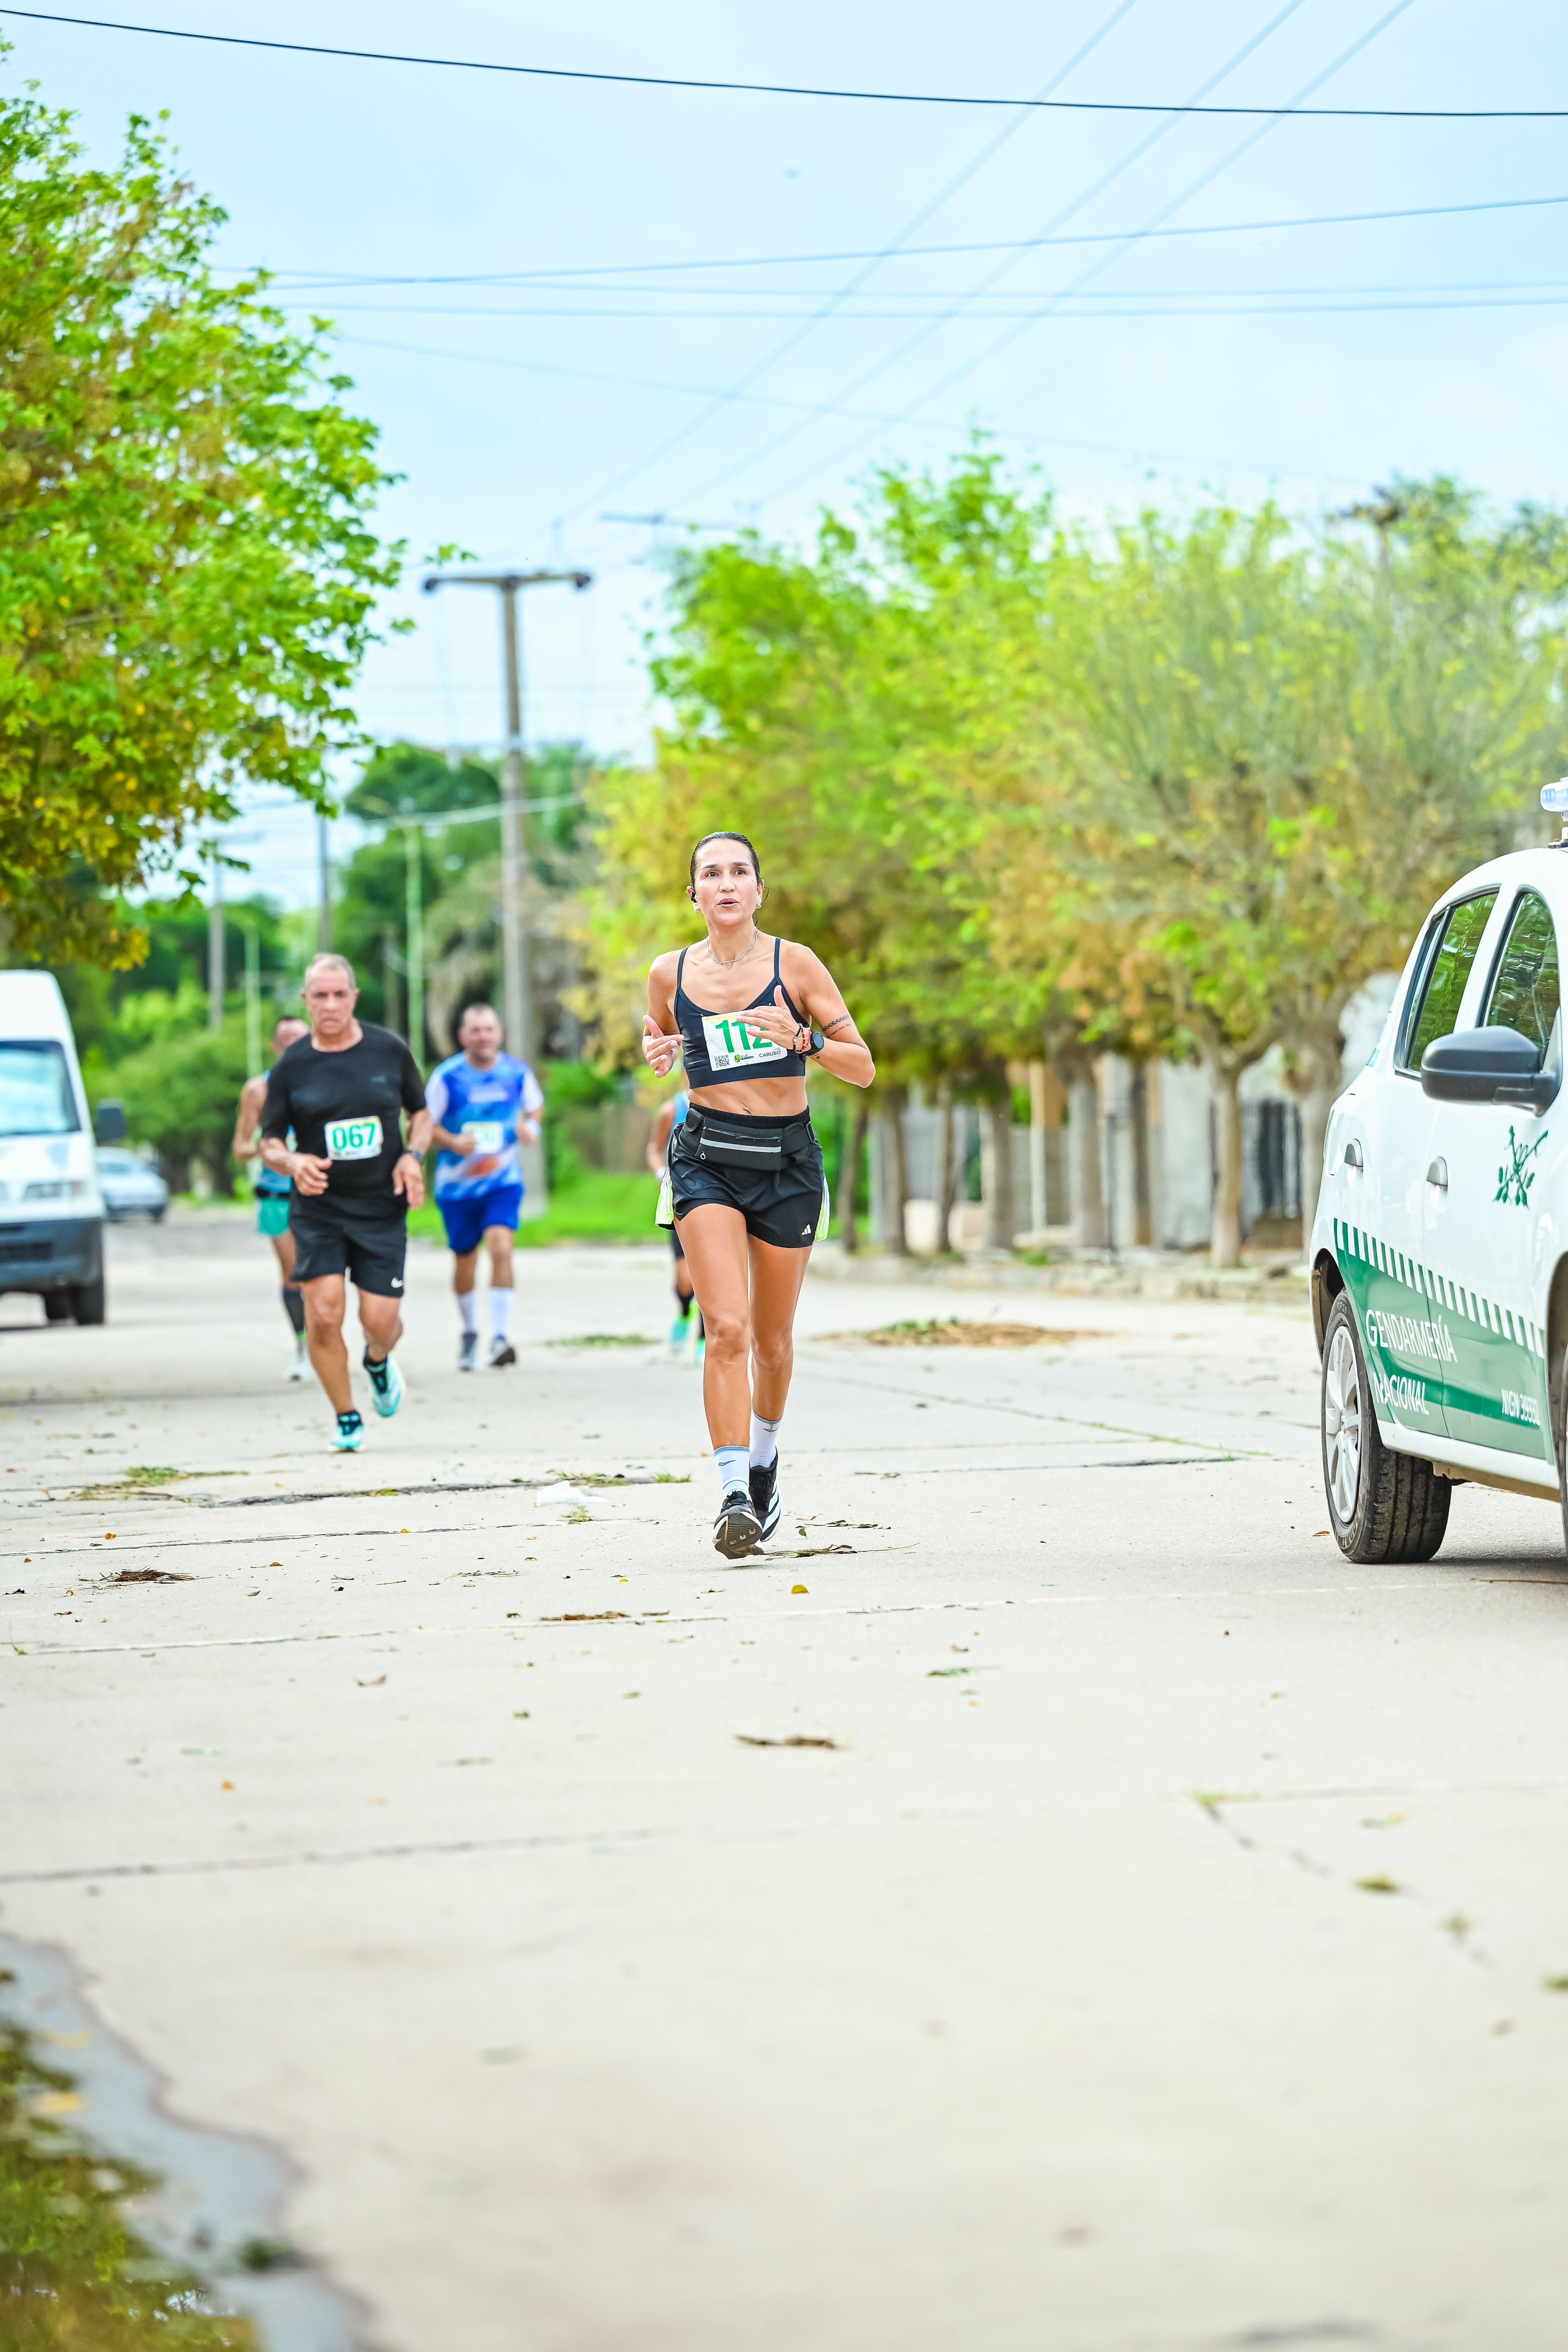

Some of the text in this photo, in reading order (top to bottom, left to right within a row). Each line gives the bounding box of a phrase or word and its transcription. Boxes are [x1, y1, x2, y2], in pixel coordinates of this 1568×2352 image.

[333, 1123, 376, 1150] 067
[1366, 1309, 1458, 1363] GENDARMERÍA
[1373, 1372, 1429, 1416] NACIONAL
